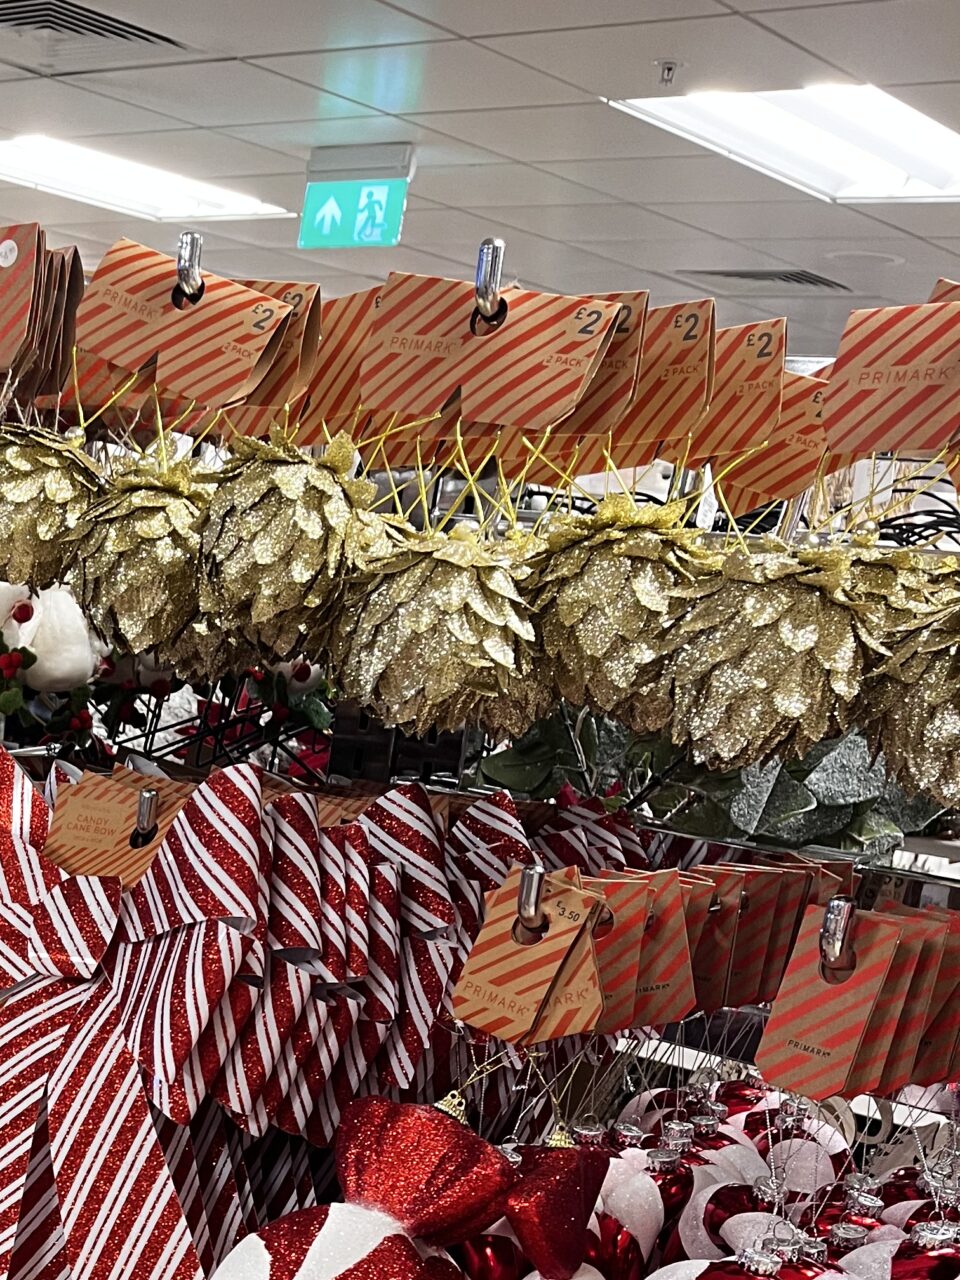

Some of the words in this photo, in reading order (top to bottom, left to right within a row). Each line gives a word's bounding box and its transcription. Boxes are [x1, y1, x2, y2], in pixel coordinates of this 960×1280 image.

[102, 288, 156, 318] PRIMARK
[251, 303, 275, 331] £2
[574, 307, 603, 336] £2
[673, 312, 700, 341] £2
[390, 337, 453, 355] PRIMARK
[746, 331, 774, 359] £2
[555, 356, 584, 369] PACK
[671, 365, 700, 379] PACK
[858, 367, 952, 385] PRIMARK
[747, 380, 776, 392] PACK
[795, 435, 820, 451] PACK
[66, 821, 91, 833] CANE
[93, 826, 118, 837] BOW
[76, 813, 110, 827] CANDY
[556, 900, 581, 923] £3.50
[464, 981, 528, 1017] PRIMARK
[787, 1039, 828, 1057] PRIMARK
